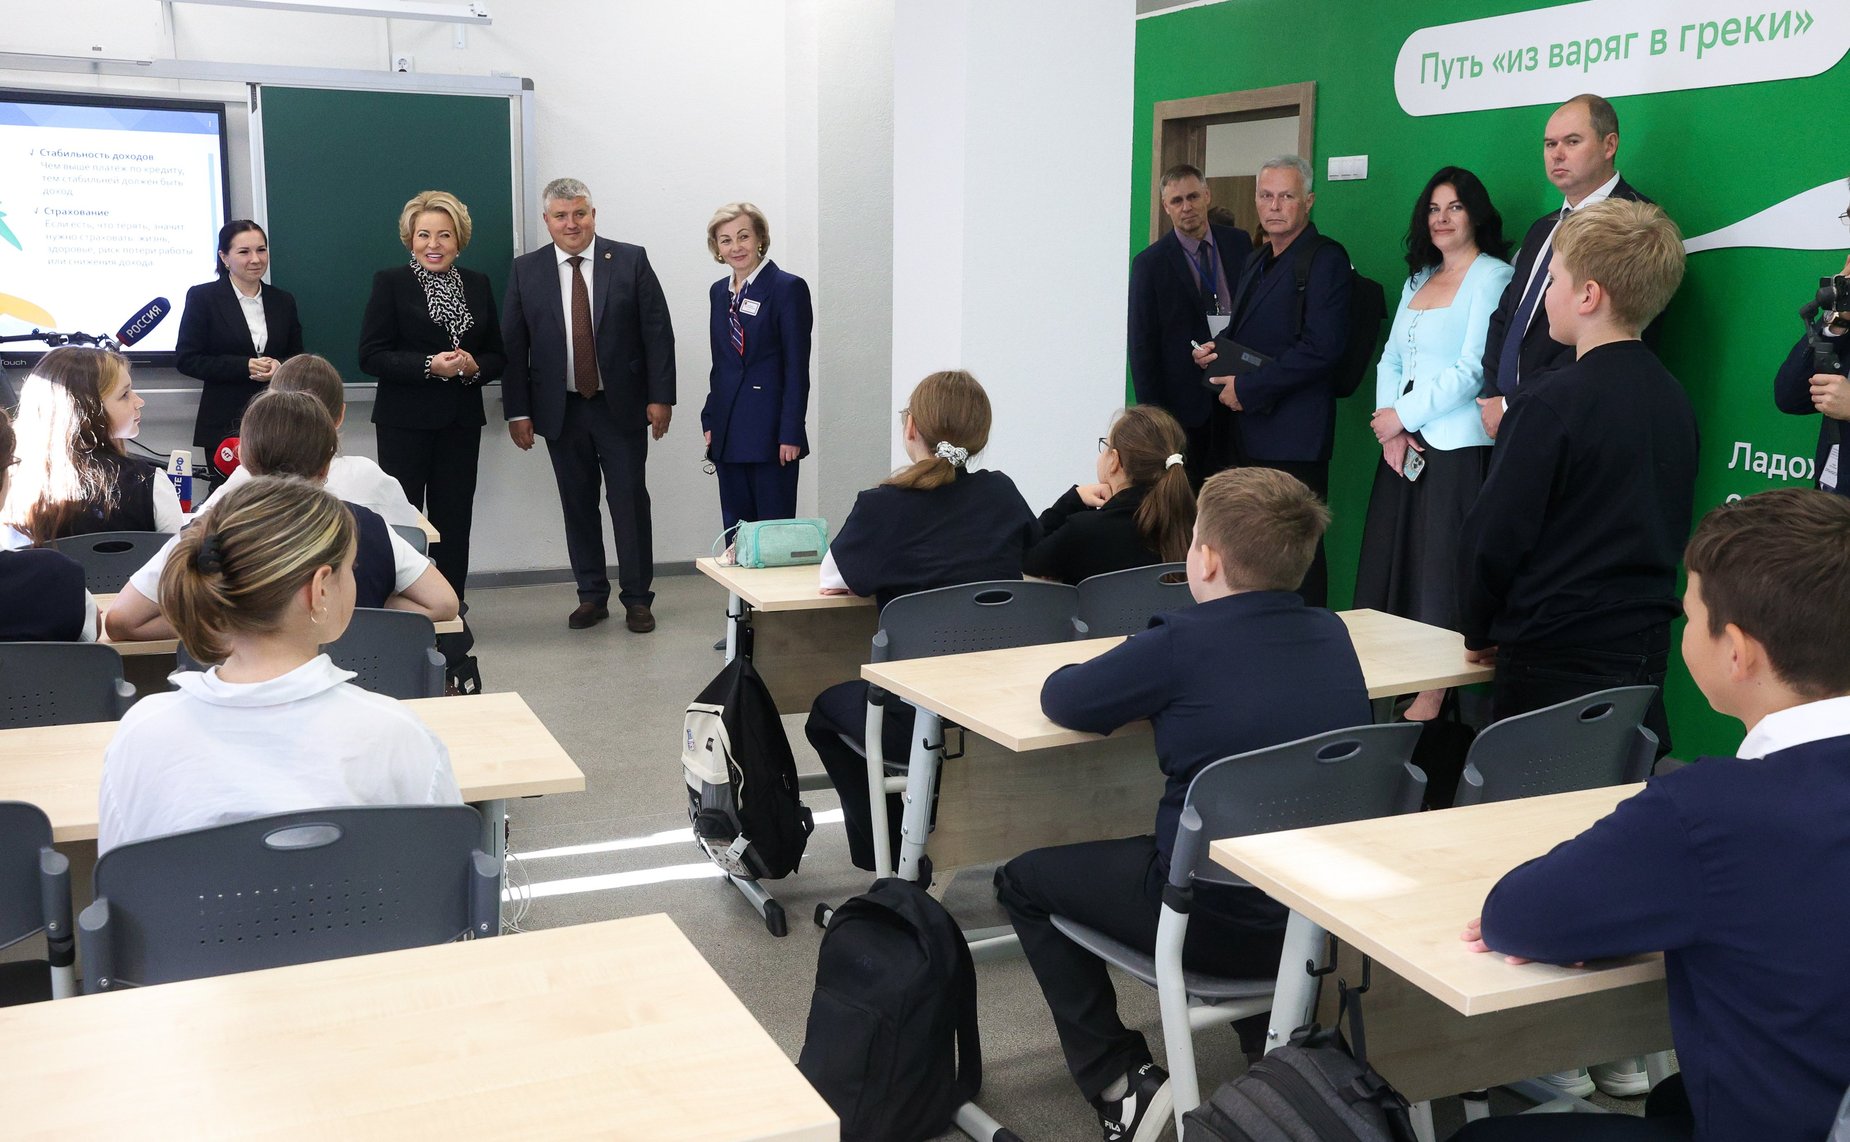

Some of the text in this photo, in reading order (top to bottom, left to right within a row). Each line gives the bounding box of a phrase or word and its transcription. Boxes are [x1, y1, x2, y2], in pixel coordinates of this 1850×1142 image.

[1420, 9, 1814, 90] Путь «из варяг в греки»
[39, 148, 154, 162] Стабильность доходов
[40, 161, 61, 170] Чем
[63, 163, 90, 172] выше
[130, 165, 142, 173] по
[143, 166, 185, 177] кредиту,
[42, 174, 62, 182] тем
[121, 176, 158, 187] должен
[160, 177, 184, 187] быть
[43, 206, 110, 218] Страхование
[45, 219, 70, 229] Если
[97, 222, 114, 230] что
[46, 233, 78, 242] нужно
[98, 246, 120, 256] риск
[122, 247, 157, 256] потери
[158, 246, 194, 256] работы
[125, 304, 163, 339] РОССИЯ
[1104, 1120, 1121, 1132] FILA
